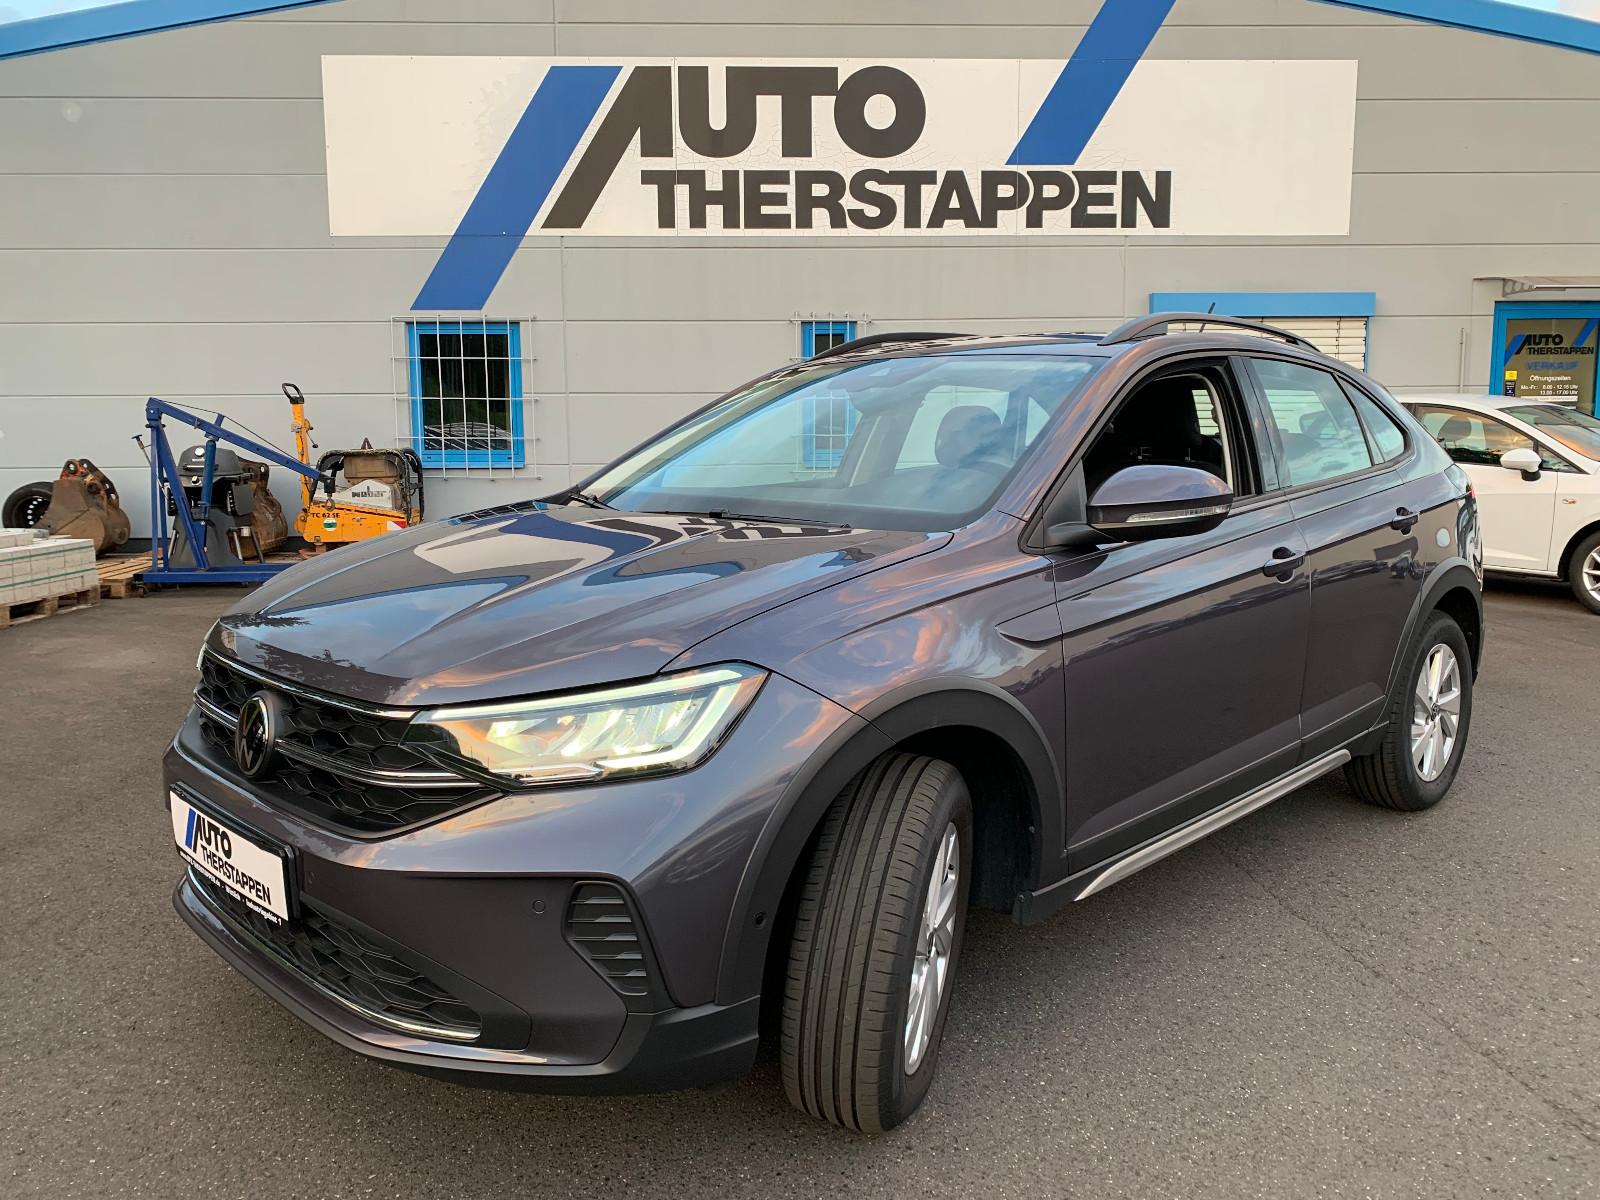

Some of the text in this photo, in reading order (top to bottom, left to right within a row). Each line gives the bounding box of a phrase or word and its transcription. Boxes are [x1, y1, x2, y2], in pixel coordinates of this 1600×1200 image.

[541, 66, 926, 228] AUTO
[640, 168, 1172, 229] THERSTAPPEN
[1515, 334, 1563, 355] AUTO
[1527, 347, 1594, 355] THERSTAPPEN
[192, 813, 232, 860] AUTO
[201, 845, 272, 905] THERSTAPPEN
